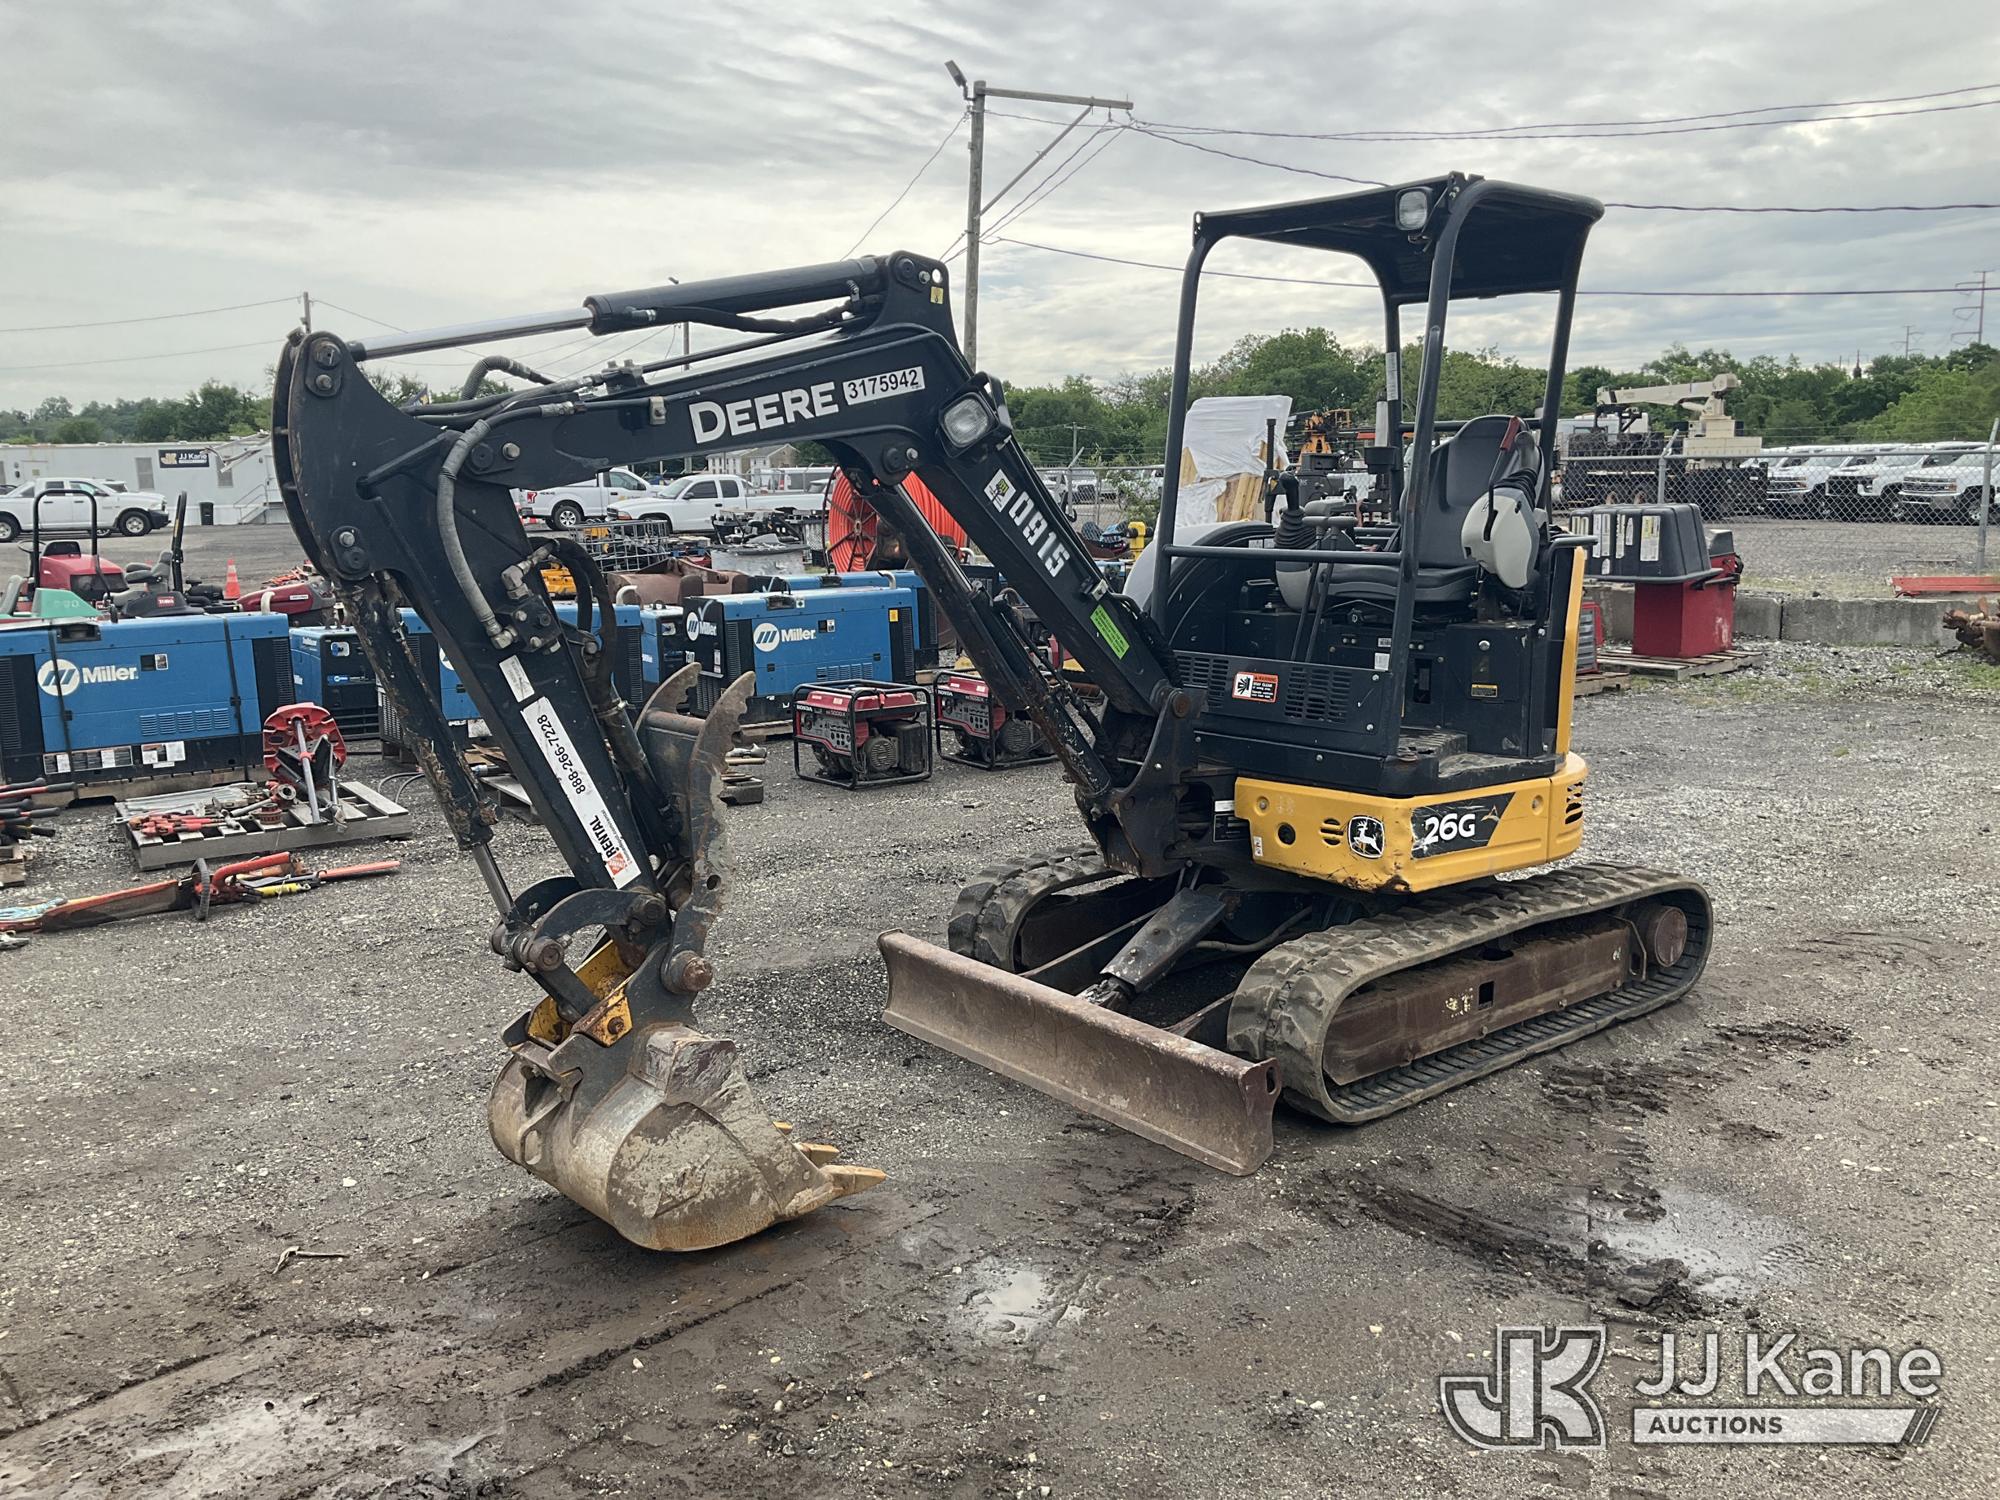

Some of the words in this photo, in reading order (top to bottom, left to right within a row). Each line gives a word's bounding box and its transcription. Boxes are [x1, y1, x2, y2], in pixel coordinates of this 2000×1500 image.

[848, 369, 919, 399] 3175942
[689, 381, 840, 444] DEERE
[1008, 491, 1070, 578] 0915
[781, 627, 816, 642] Miller
[82, 665, 138, 684] Miller
[537, 713, 587, 795] 888-266-7228
[589, 814, 615, 858] RENTAL
[1423, 812, 1476, 846] 26G
